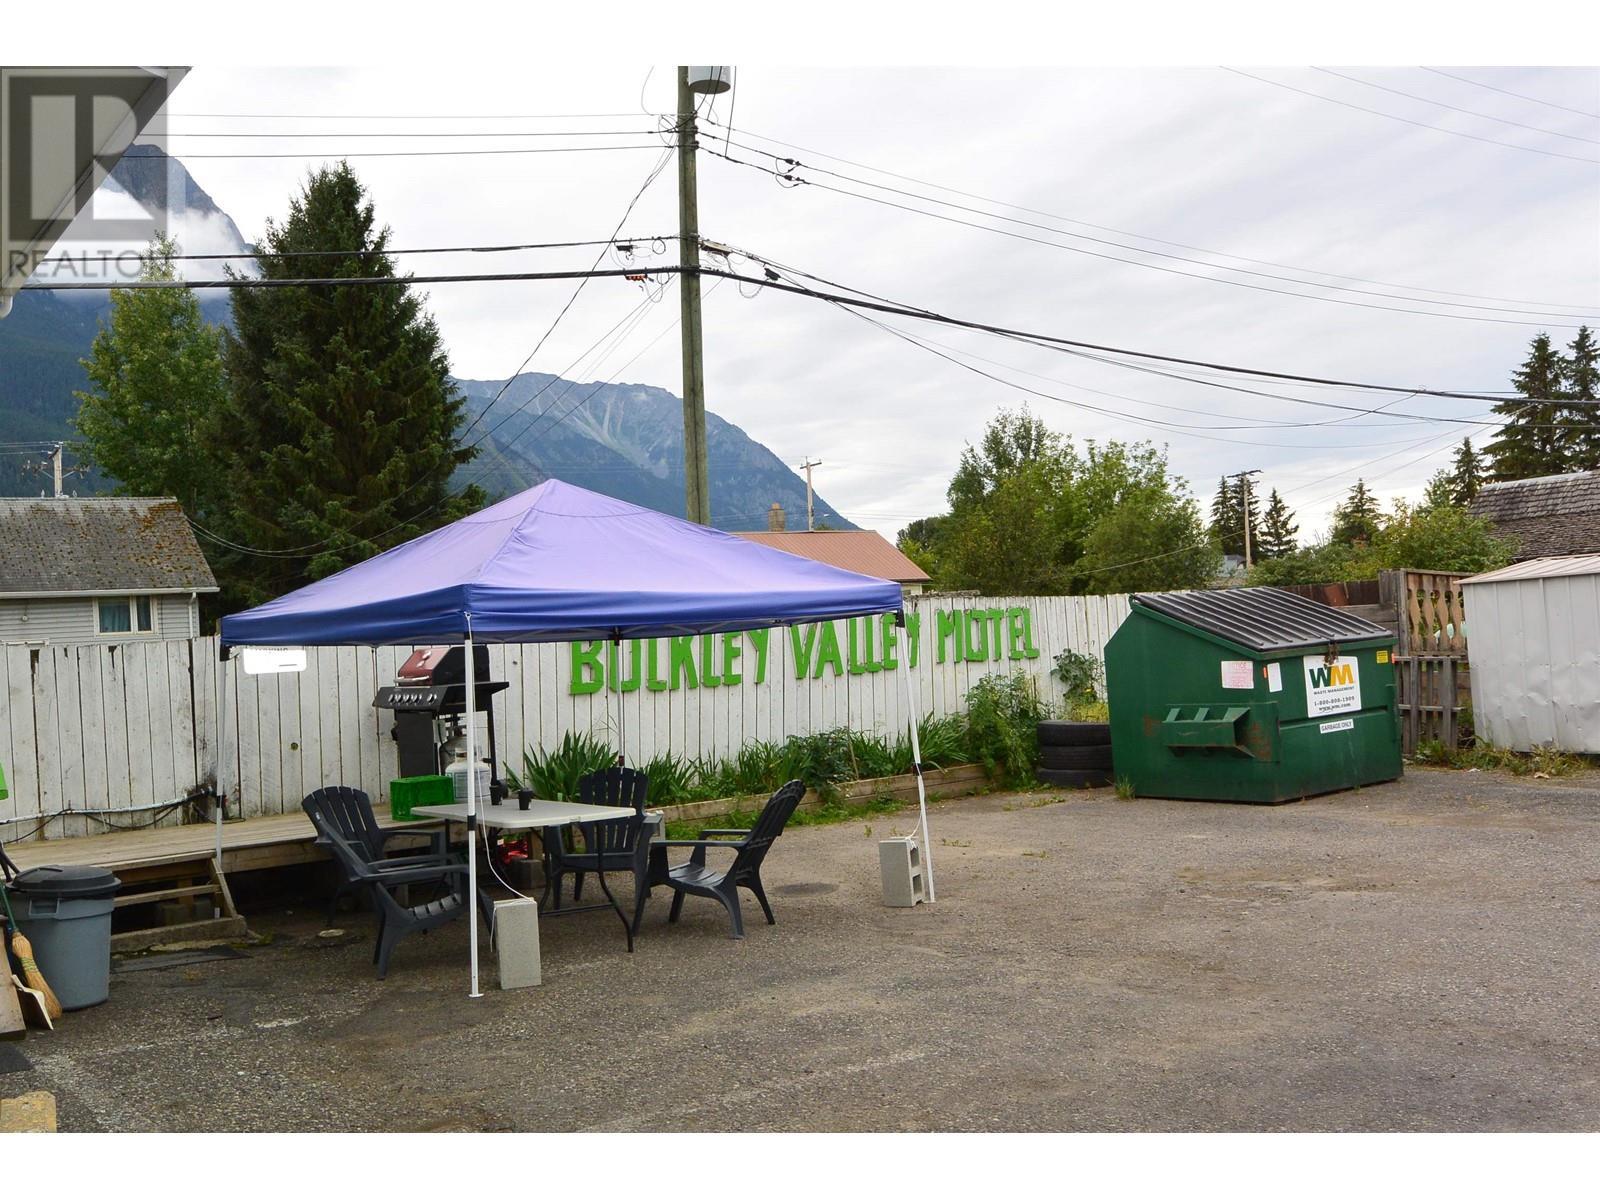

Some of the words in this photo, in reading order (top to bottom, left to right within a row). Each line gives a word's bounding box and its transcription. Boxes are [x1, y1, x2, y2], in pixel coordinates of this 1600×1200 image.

[569, 628, 769, 695] BULKLEY
[789, 611, 921, 679] VALLEY
[936, 607, 1039, 664] MOTEL
[1309, 664, 1353, 688] WM
[1321, 722, 1341, 732] GARBAGE
